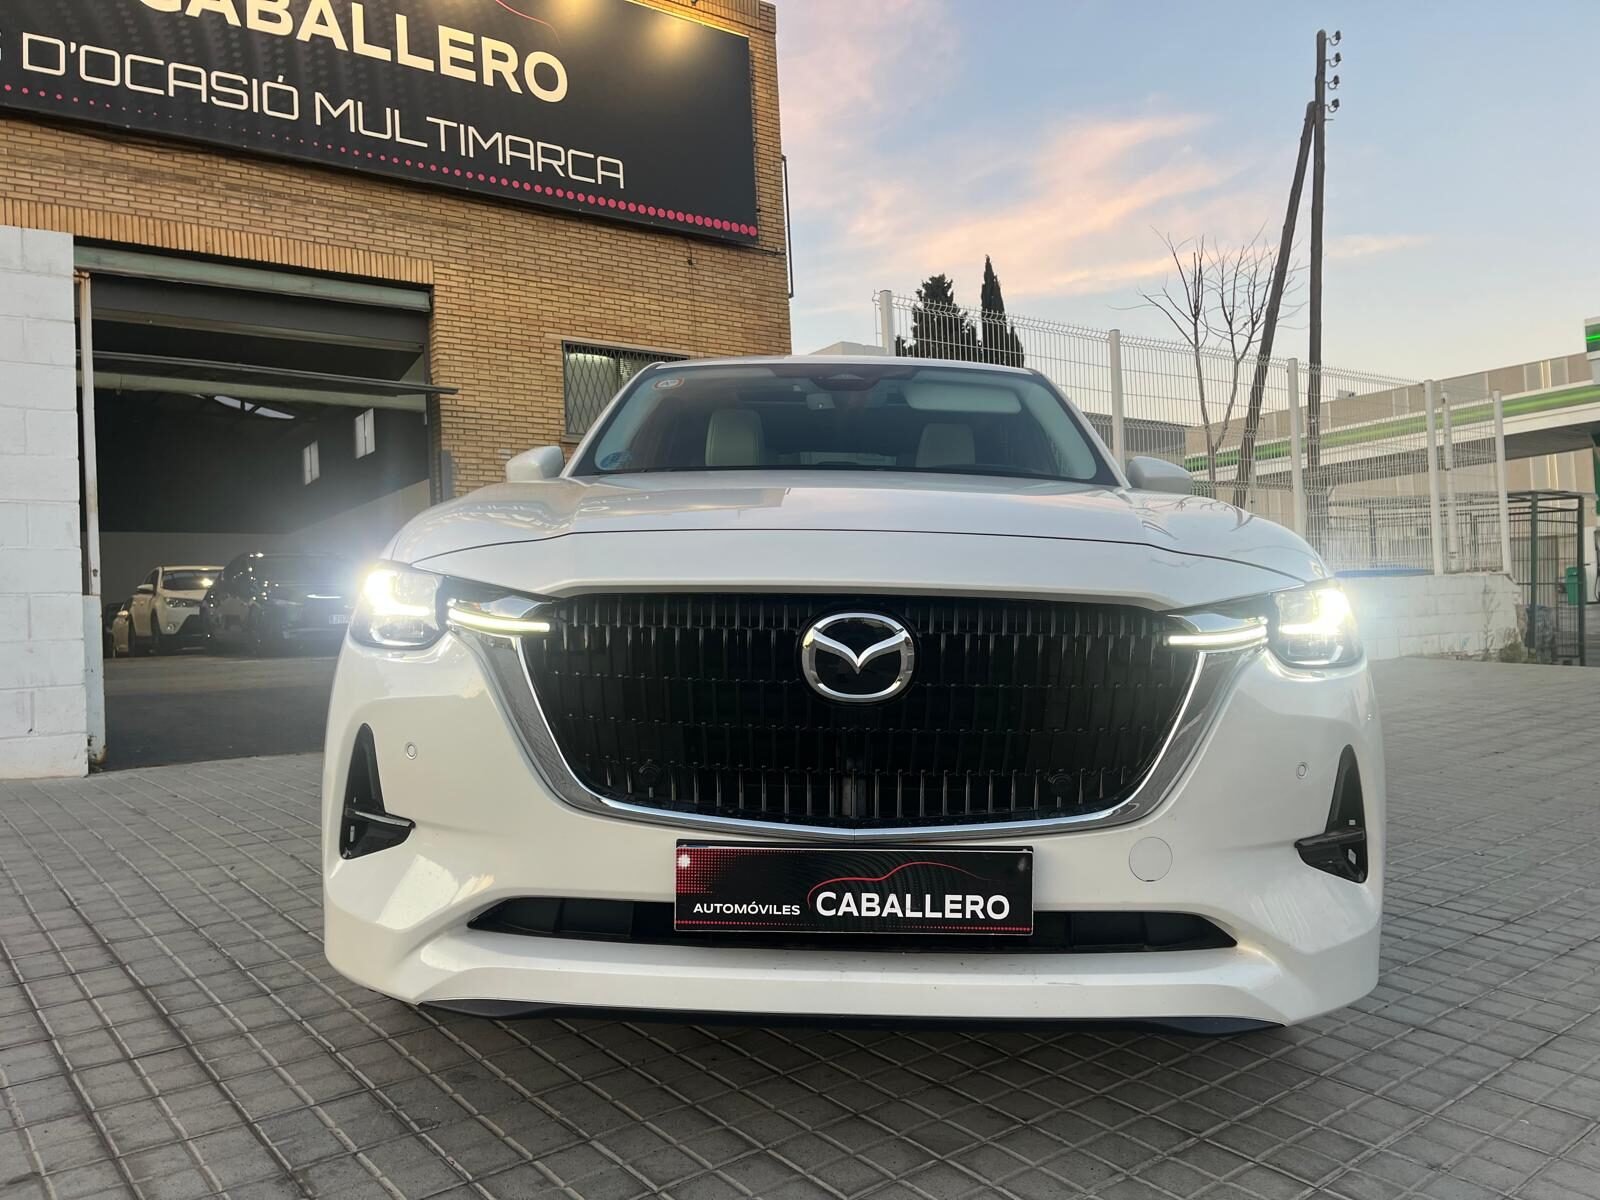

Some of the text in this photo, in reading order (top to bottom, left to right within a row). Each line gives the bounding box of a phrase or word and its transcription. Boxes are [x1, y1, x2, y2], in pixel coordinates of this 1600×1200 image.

[139, 0, 568, 103] ABALLERO
[22, 31, 625, 190] D'OCASIÓ MULTIMARCA
[692, 891, 1010, 920] AUTOMÓVILES CABALLERO
